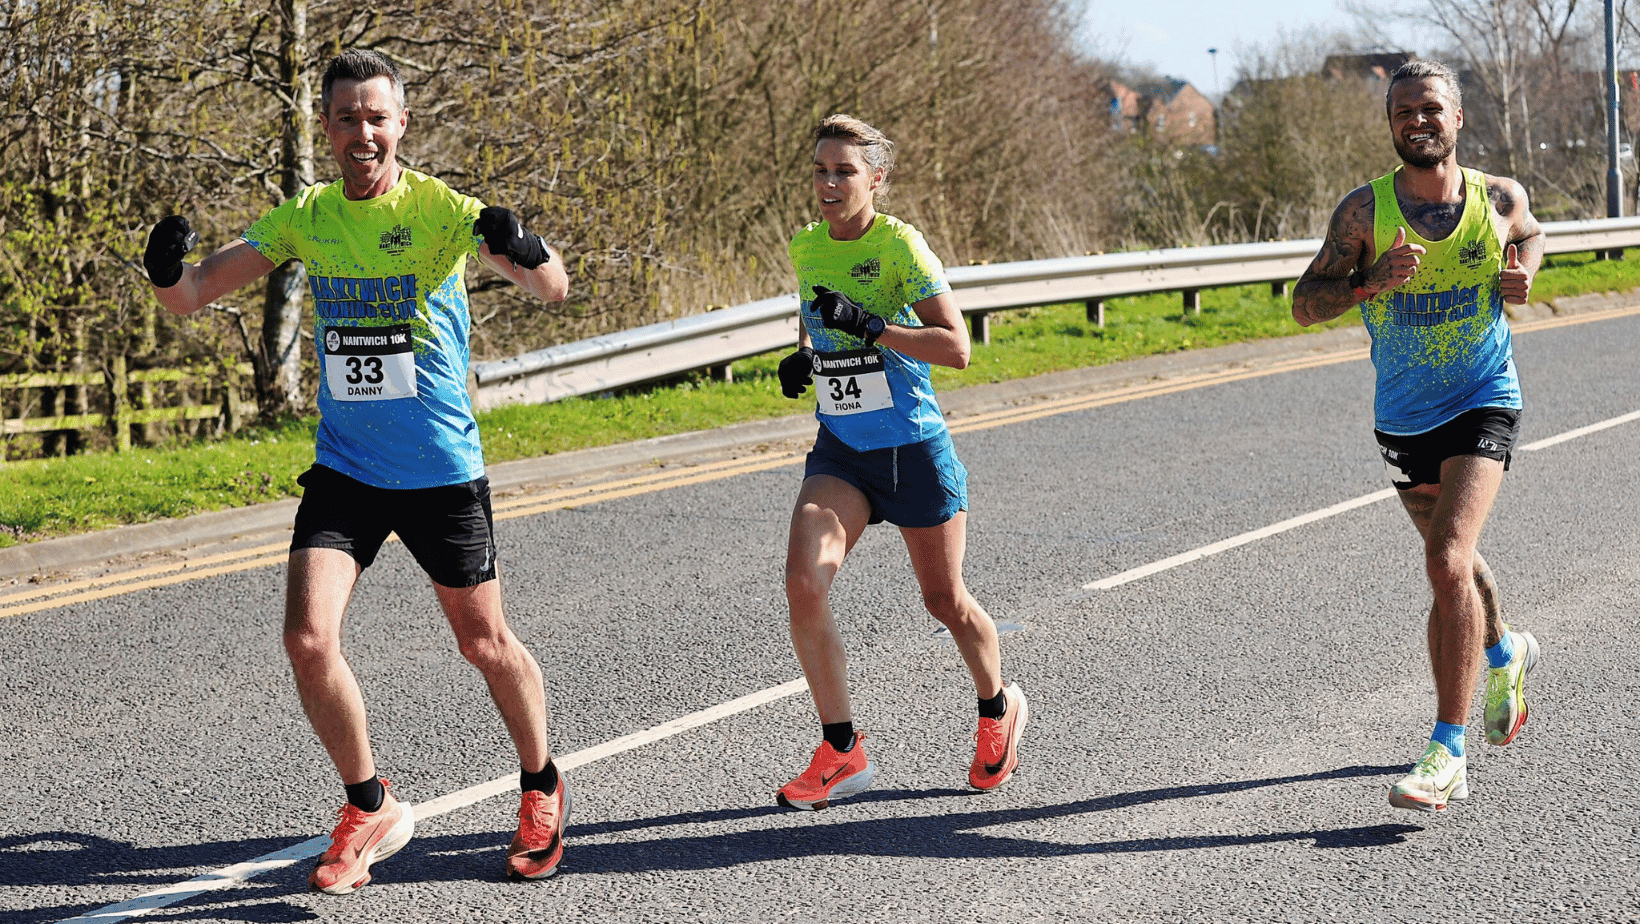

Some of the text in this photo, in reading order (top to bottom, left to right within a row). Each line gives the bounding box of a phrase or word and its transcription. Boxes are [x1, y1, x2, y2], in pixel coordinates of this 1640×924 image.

[1394, 284, 1479, 312] NANTWICH
[1394, 302, 1478, 327] RUNNING CLUB
[342, 335, 388, 346] NANTWICH
[390, 333, 407, 345] 10K
[345, 356, 384, 384] 33
[822, 355, 879, 369] NANTWICH 10K
[347, 386, 383, 396] DANNY
[828, 376, 862, 401] 34
[835, 401, 862, 411] FIONA
